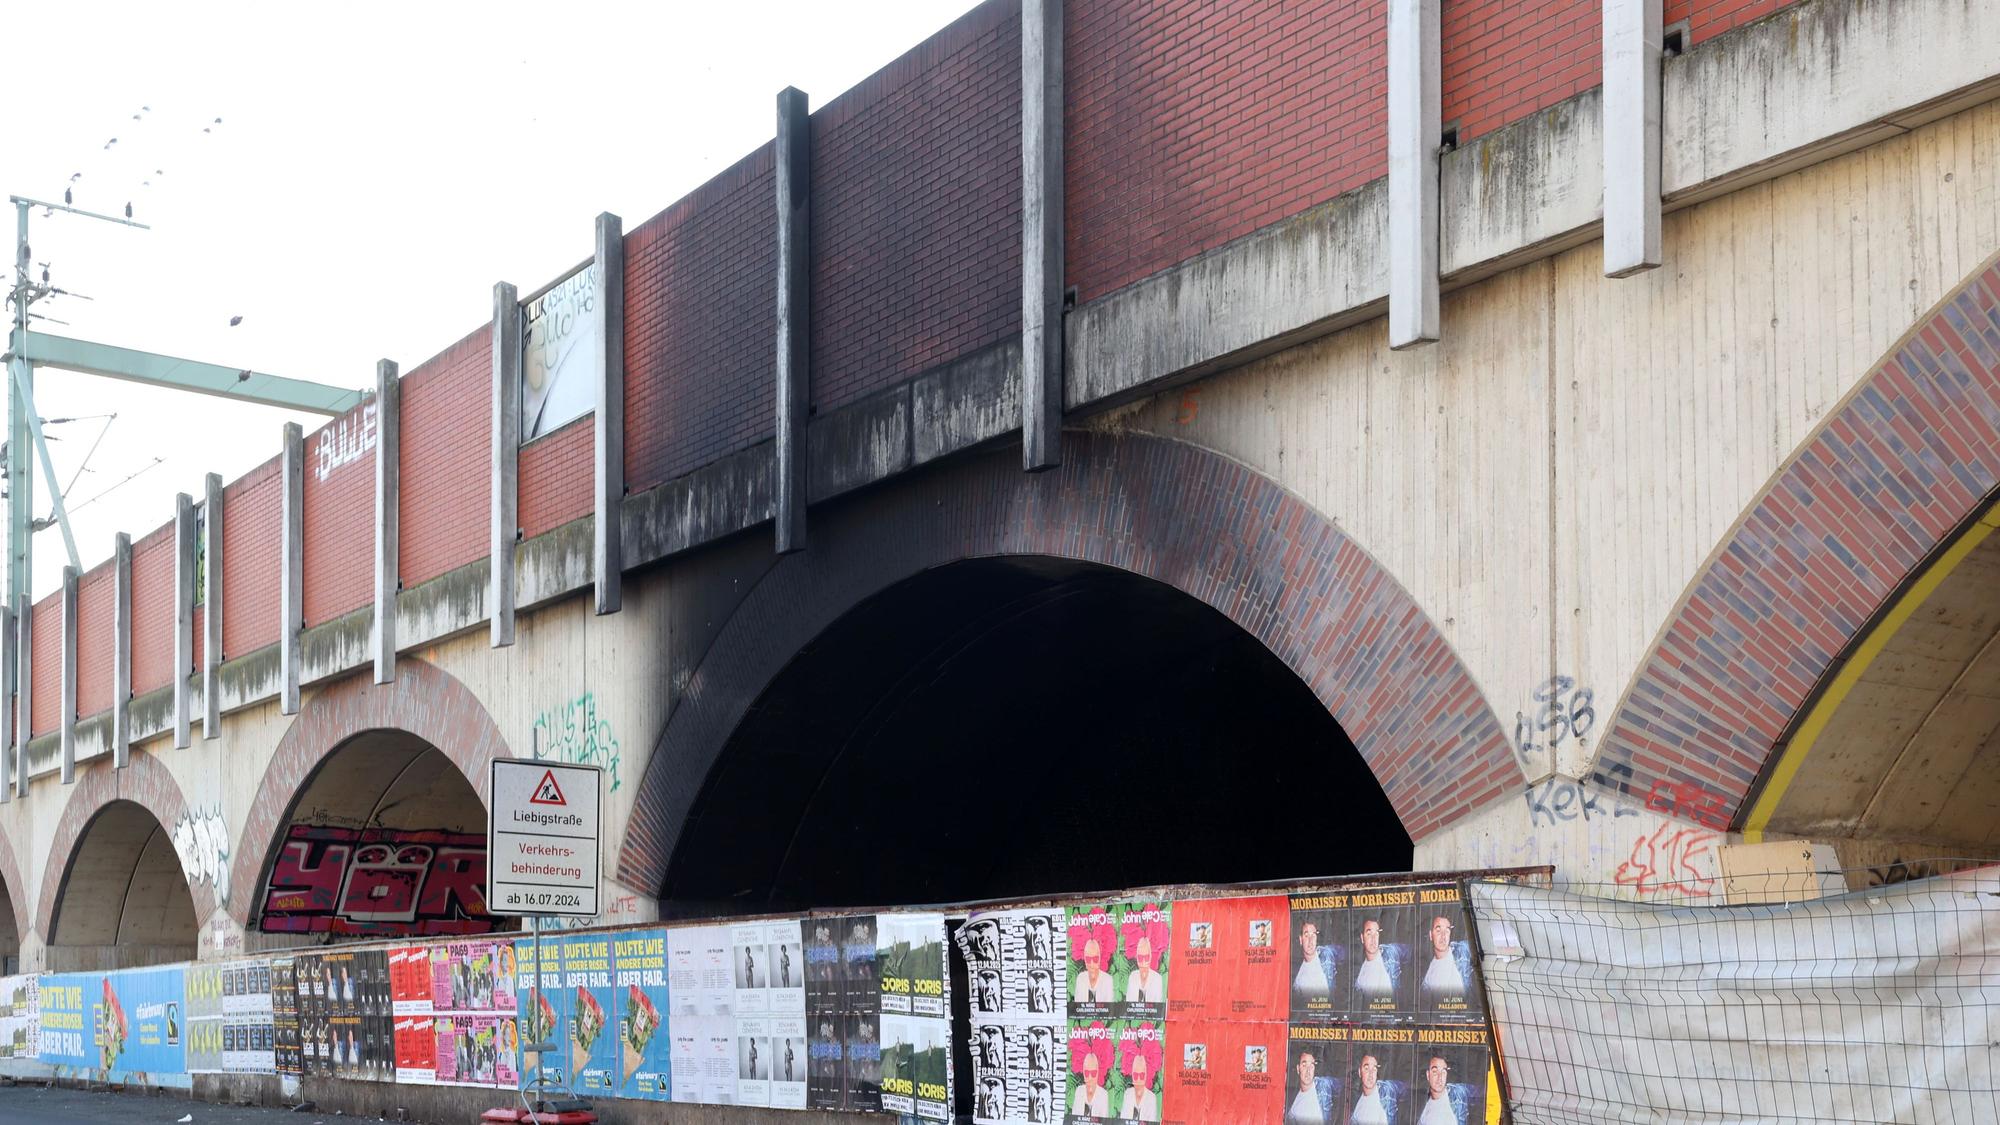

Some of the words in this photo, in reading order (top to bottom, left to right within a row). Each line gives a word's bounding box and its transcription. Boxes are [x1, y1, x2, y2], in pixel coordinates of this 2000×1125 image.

[514, 810, 583, 826] Liebigstraße
[519, 843, 575, 857] Verkehrs-
[511, 862, 581, 880] behinderung
[507, 893, 521, 904] ab
[524, 893, 580, 906] 16.07.2024
[1290, 895, 1348, 910] MORRISSEY
[1352, 891, 1415, 907] MORRISSEY
[1420, 888, 1461, 903] MORRI
[1068, 914, 1088, 926] John
[1122, 911, 1141, 924] John
[543, 944, 559, 960] WIE
[564, 943, 590, 959] DUFTE
[591, 942, 608, 957] WIE
[614, 940, 644, 957] DUFTE
[644, 938, 664, 955] WIE
[518, 974, 535, 989] ABE
[566, 972, 588, 987] ABER
[589, 972, 611, 987] FAIR.
[617, 971, 641, 987] ABER
[642, 970, 666, 987] FAIR.
[881, 977, 910, 993] JORIS
[913, 979, 942, 994] JORIS
[1069, 1028, 1088, 1039] John
[1120, 1028, 1138, 1040] John
[1290, 1027, 1348, 1041] MORRISSEY
[1352, 1028, 1414, 1043] MORRISSEY
[1418, 1029, 1487, 1044] MORRISSEY
[40, 1030, 62, 1055] ABER
[881, 1077, 914, 1095] JORIS
[918, 1082, 946, 1100] JORIS
